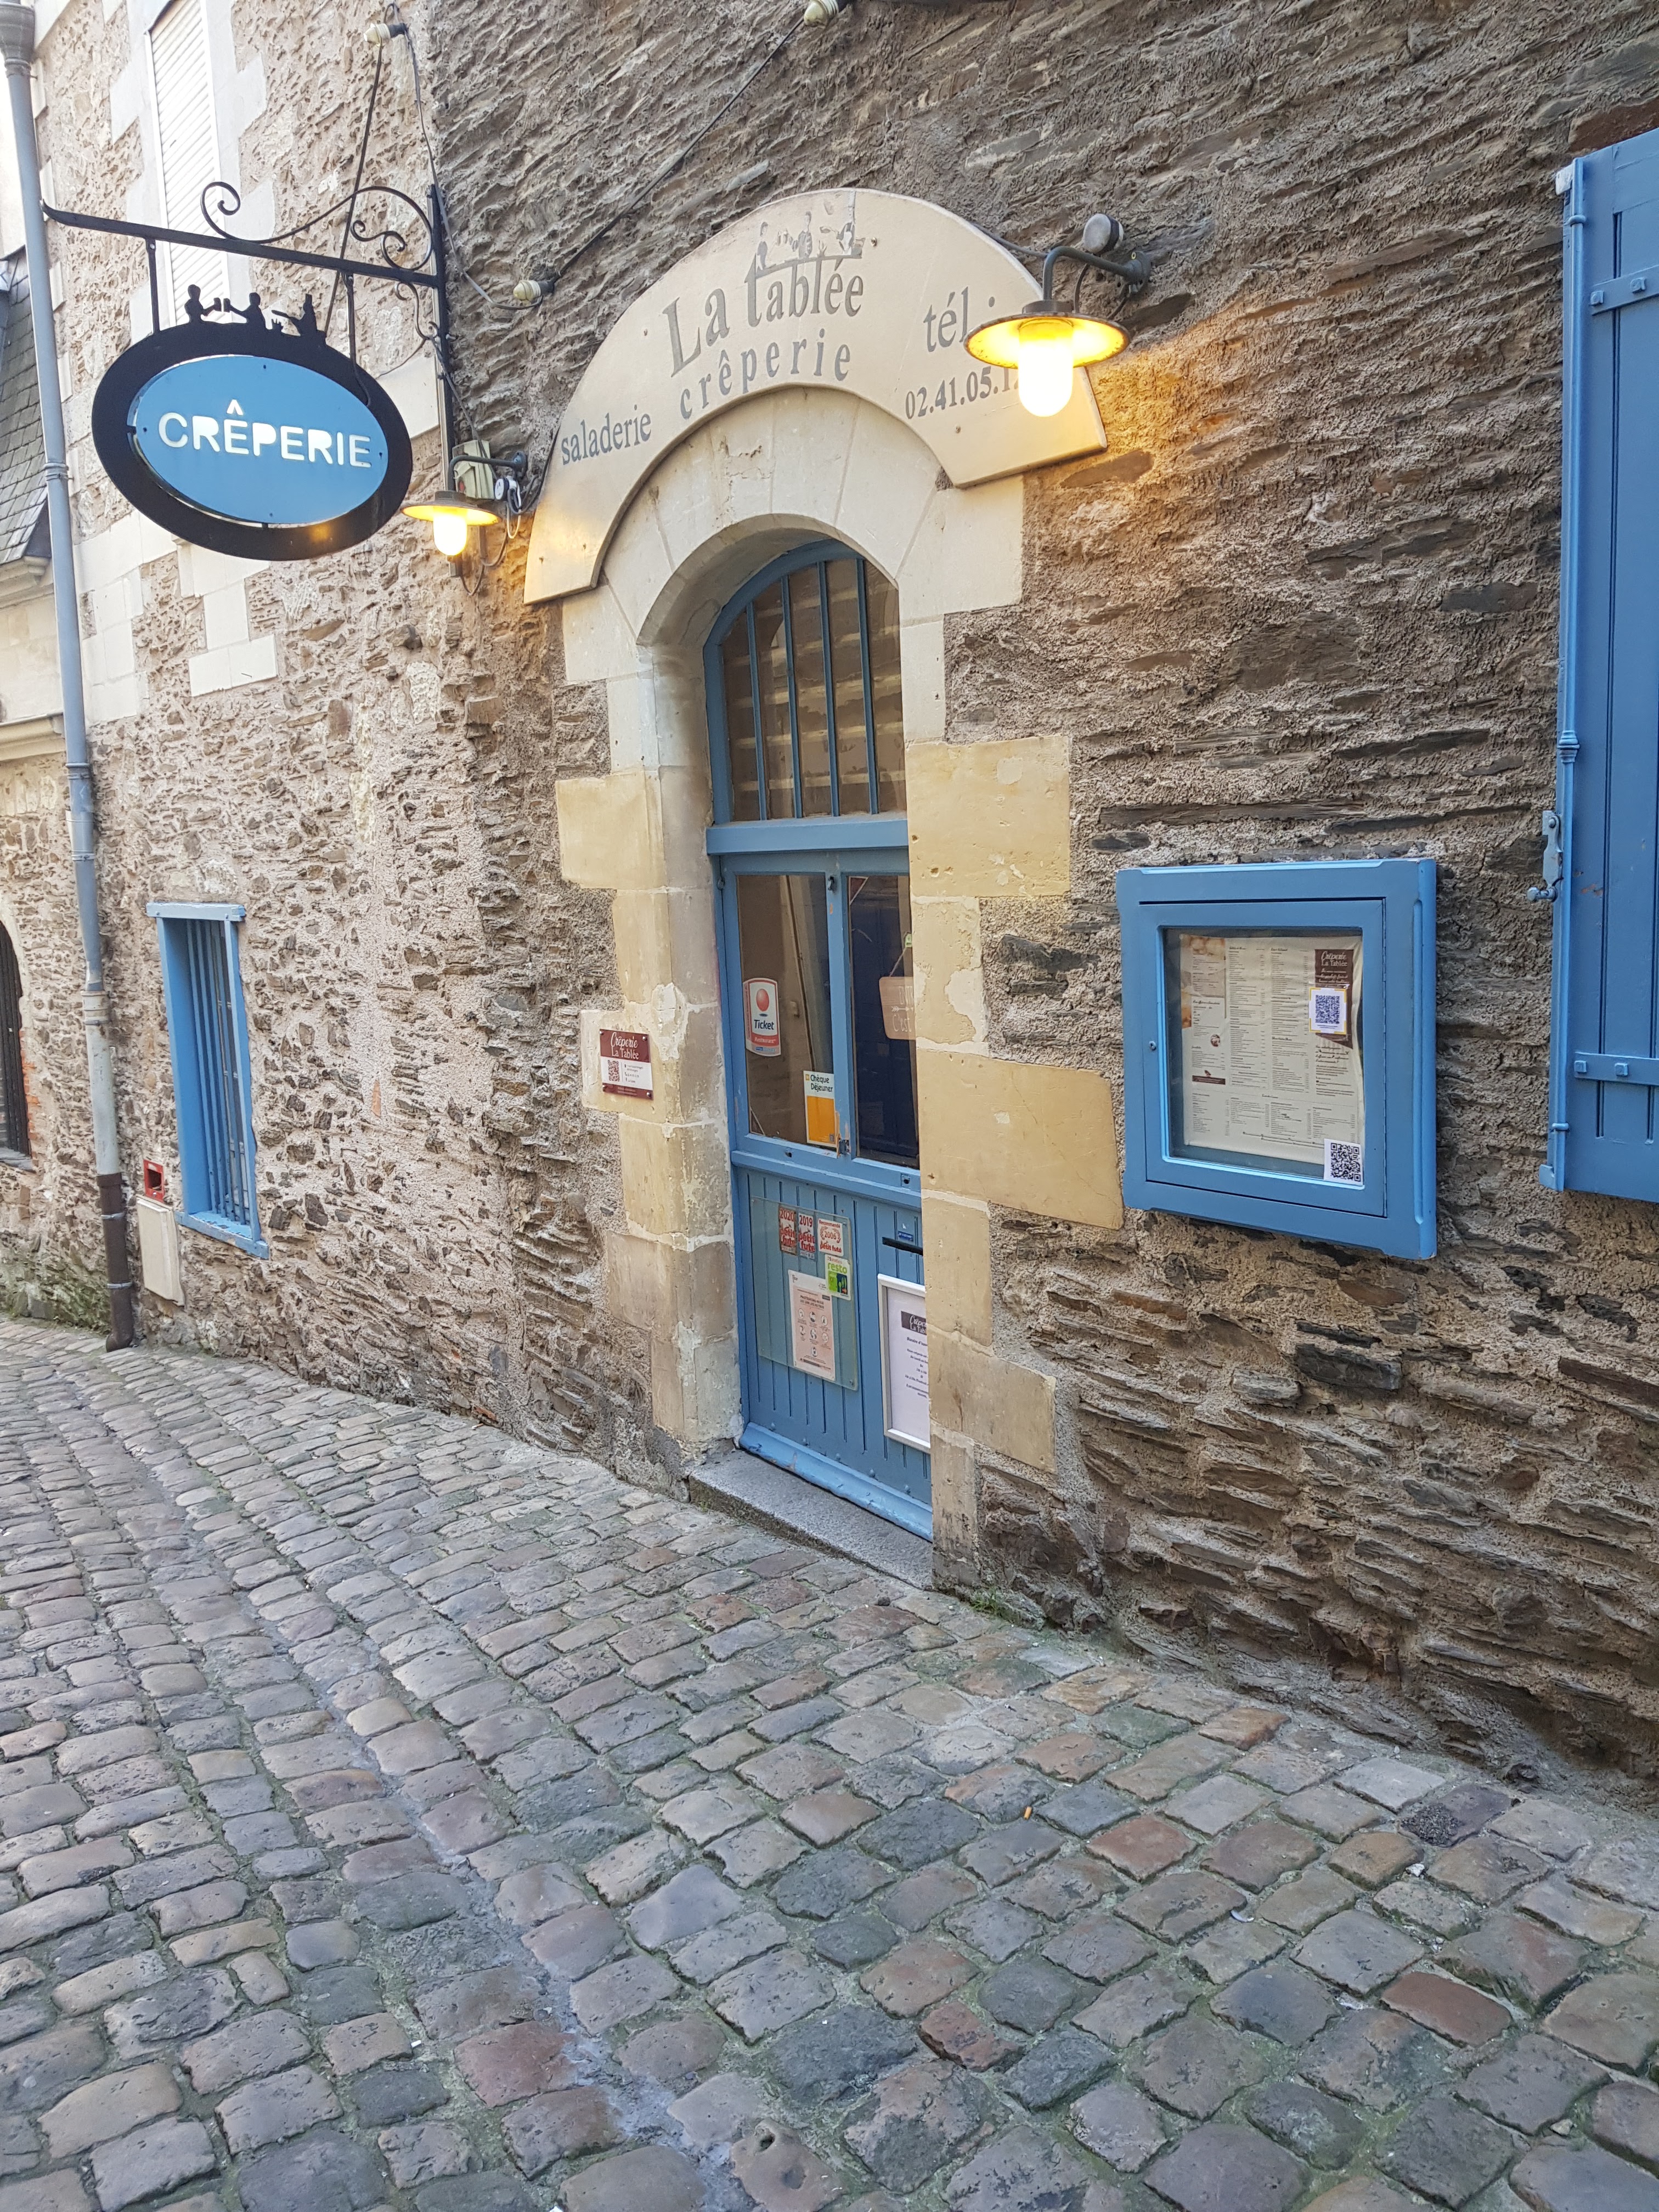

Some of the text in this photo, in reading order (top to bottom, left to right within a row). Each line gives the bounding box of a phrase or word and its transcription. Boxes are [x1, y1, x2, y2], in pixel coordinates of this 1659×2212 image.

[662, 252, 864, 377] La tablée
[923, 286, 969, 352] tél
[680, 329, 850, 420] crêperie
[158, 399, 371, 468] CRÊPERIE
[561, 404, 652, 465] saladerie
[754, 1019, 774, 1030] Ticket
[611, 1032, 639, 1049] Crêperie
[611, 1047, 639, 1059] La Tablée
[810, 1074, 830, 1084] Chèque
[811, 1082, 833, 1092] Déjeuner
[780, 1209, 794, 1222] 2020
[799, 1215, 813, 1228] 2019
[825, 1231, 837, 1240] 2006
[828, 1262, 847, 1274] resto
